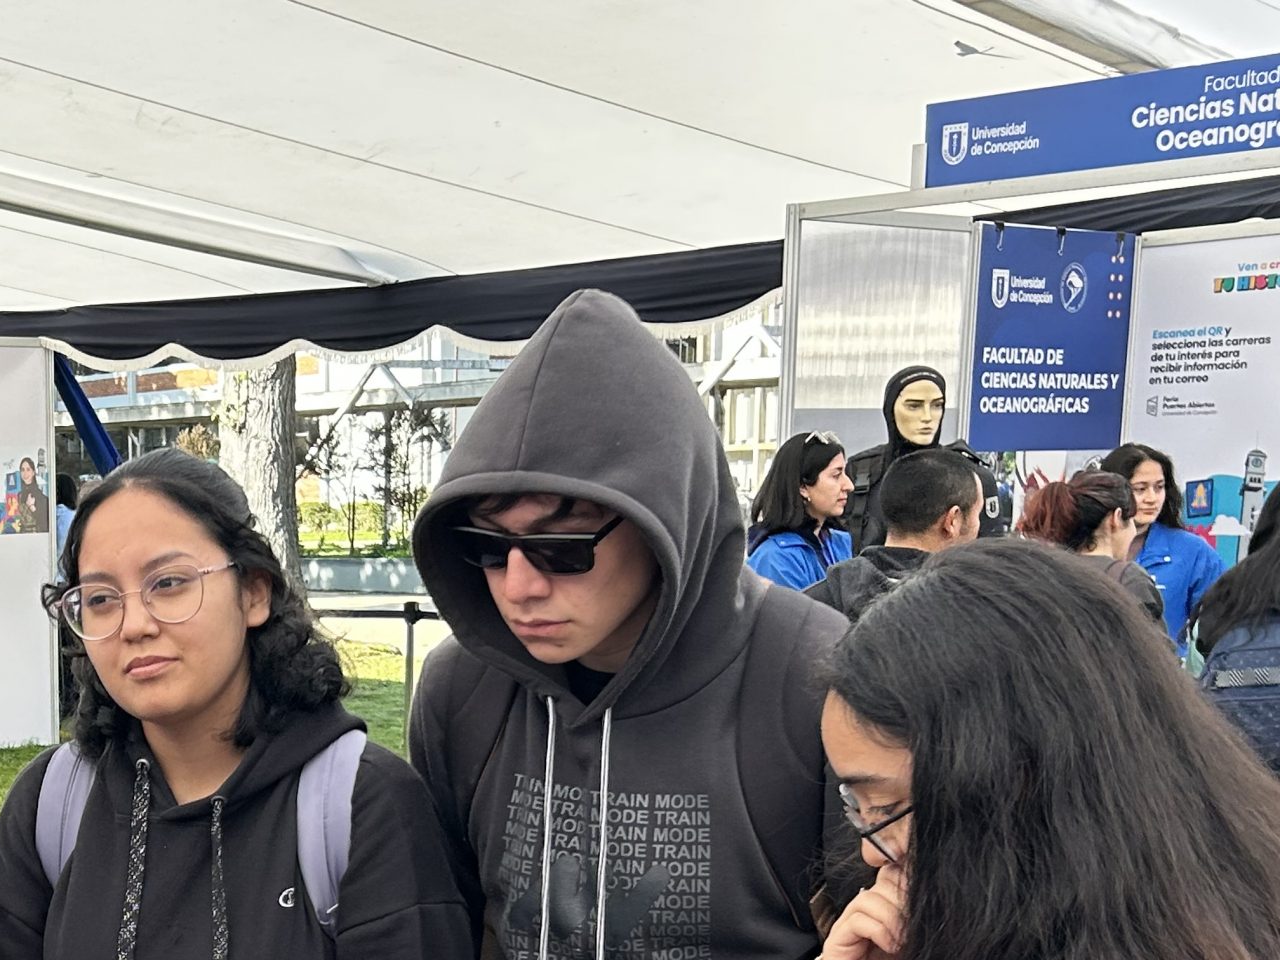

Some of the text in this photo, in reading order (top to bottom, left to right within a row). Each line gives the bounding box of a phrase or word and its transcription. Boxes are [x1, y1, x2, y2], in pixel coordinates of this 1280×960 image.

[1204, 65, 1280, 93] Facultad
[1131, 94, 1234, 129] Ciencias
[972, 121, 1027, 141] Universidad
[970, 137, 1040, 157] de Concepción
[1237, 262, 1258, 272] Ven
[1260, 262, 1267, 270] a
[1010, 275, 1046, 290] Universidad
[1213, 276, 1235, 294] TU
[1009, 291, 1054, 306] de Concepción
[1152, 325, 1232, 340] Escanea el QR y
[1151, 336, 1271, 351] selecciona las carreras
[982, 346, 1064, 365] FACULTAD DE
[1150, 349, 1240, 362] de tu interés para
[1150, 360, 1248, 374] recibir información
[981, 371, 1120, 390] CIENCIAS NATURALES Y
[1149, 374, 1209, 385] en tu correo
[979, 392, 1090, 414] OCEANOGRÁFICAS
[654, 793, 710, 809] MODE
[653, 810, 711, 826] TRAIN
[653, 827, 711, 843] MODE
[652, 844, 712, 860] TRAIN
[651, 860, 711, 877] ODE
[663, 878, 711, 893] RAIN
[648, 909, 711, 924] TRAIN
[649, 924, 711, 937] MODE
